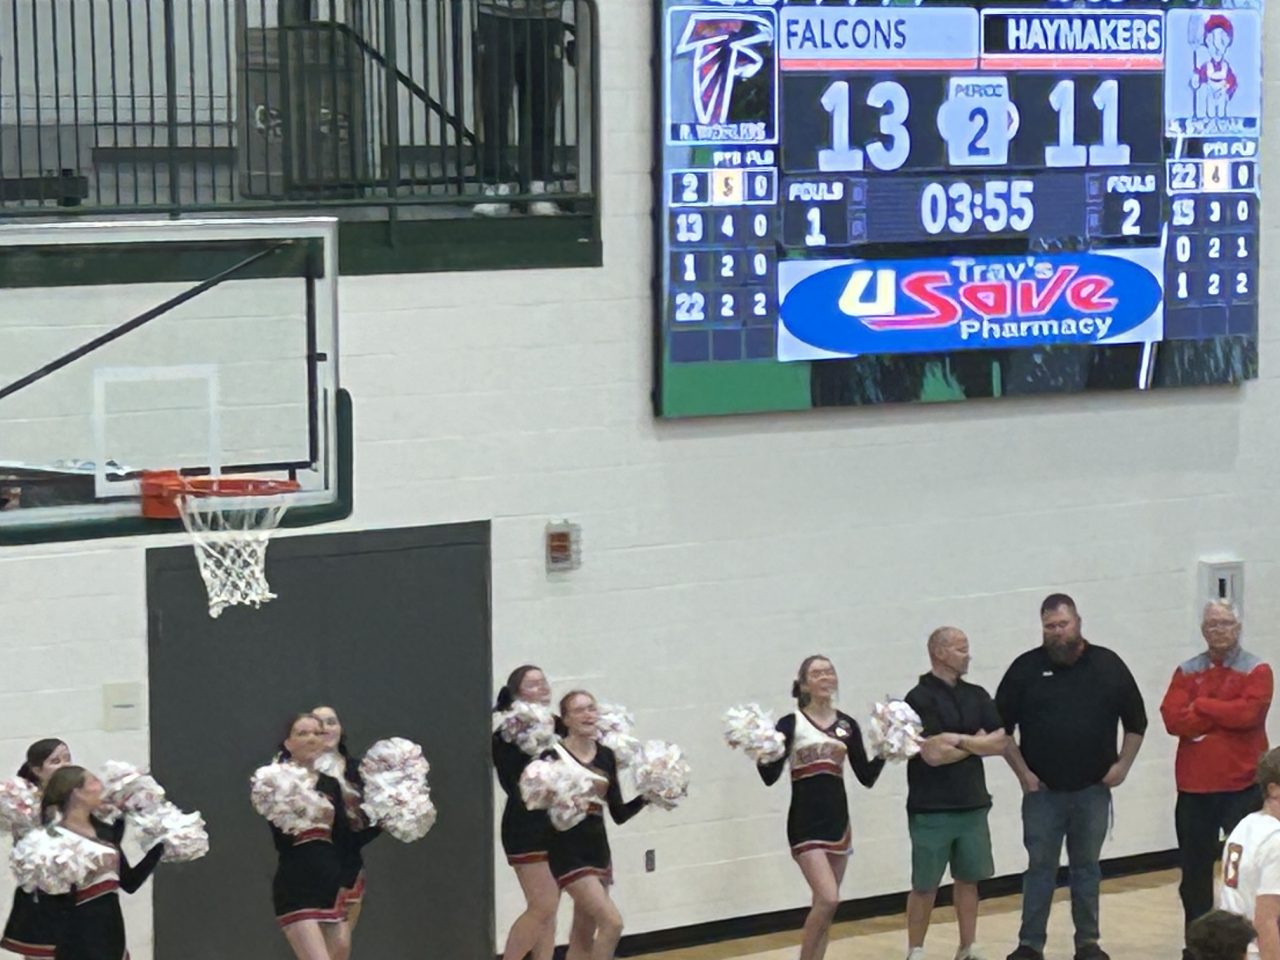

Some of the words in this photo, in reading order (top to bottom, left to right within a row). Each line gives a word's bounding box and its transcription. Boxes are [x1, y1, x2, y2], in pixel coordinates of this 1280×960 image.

[786, 19, 907, 49] FALCONS
[1007, 18, 1161, 51] HAYMAKERS
[818, 80, 911, 171] 13
[968, 107, 990, 156] 2
[1045, 79, 1131, 167] 11
[682, 173, 698, 201] 2
[754, 174, 767, 198] 0
[1171, 163, 1196, 189] 22
[1238, 164, 1249, 186] 0
[921, 180, 1034, 235] 03:55
[1122, 198, 1141, 236] 2
[1237, 200, 1249, 222] 0
[676, 213, 703, 242] 13
[721, 214, 734, 238] 4
[754, 213, 767, 237] 0
[804, 206, 826, 246] 1
[1176, 235, 1191, 263] 0
[1208, 237, 1221, 259] 2
[1238, 236, 1249, 258] 1
[684, 253, 696, 281] 1
[721, 254, 734, 277] 2
[754, 253, 767, 276] 0
[1177, 273, 1188, 299] 1
[1208, 273, 1221, 295] 2
[1236, 272, 1249, 294] 2
[675, 291, 705, 321] 22
[721, 293, 734, 317] 2
[753, 292, 767, 316] 2
[959, 316, 1113, 340] Pharmacy
